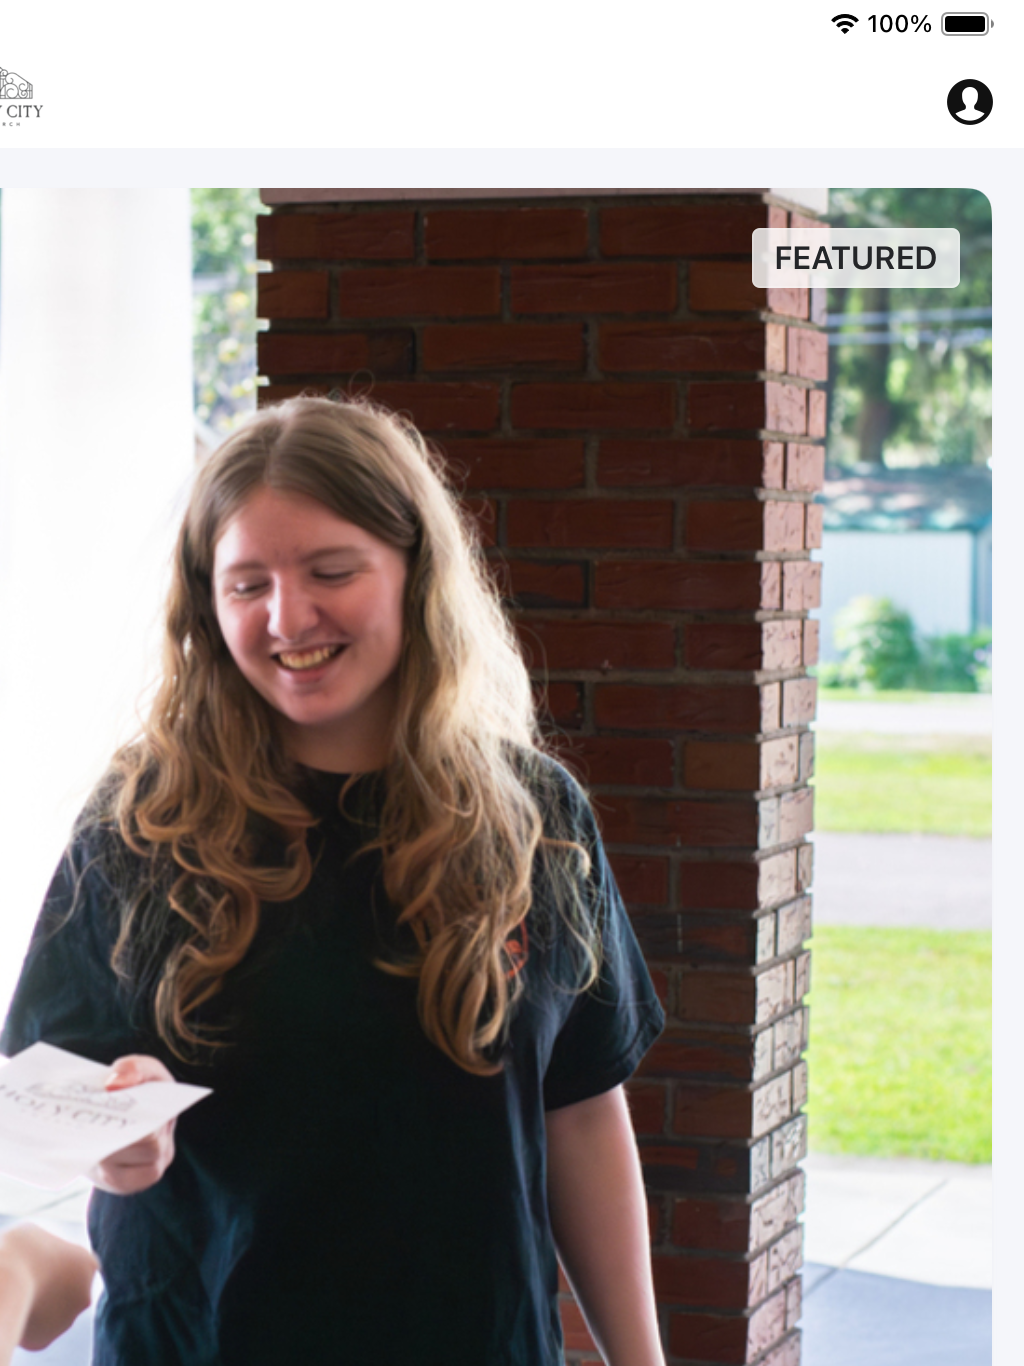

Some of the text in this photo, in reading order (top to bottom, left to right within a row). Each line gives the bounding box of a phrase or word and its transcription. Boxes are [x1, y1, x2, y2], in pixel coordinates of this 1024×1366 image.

[867, 14, 932, 34] 100%
[6, 104, 44, 118] CITY
[776, 245, 937, 271] FEATURED
[72, 1109, 137, 1130] CITY
